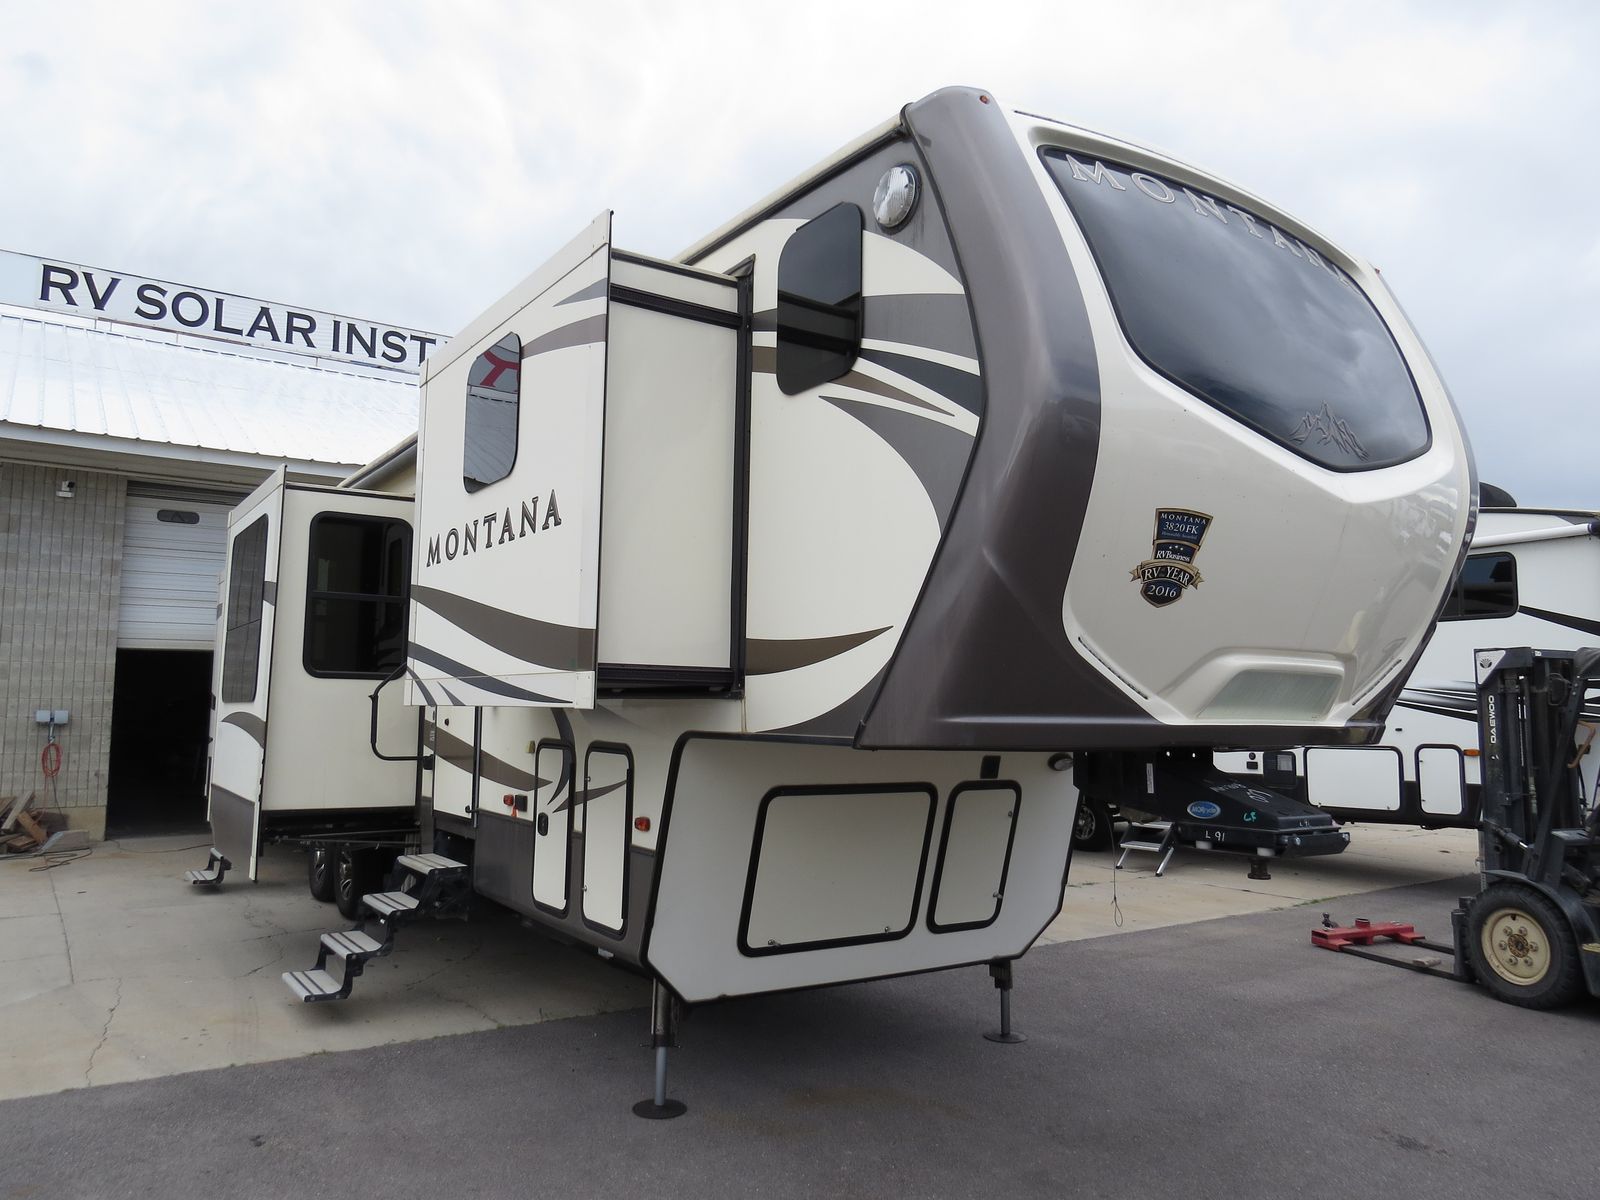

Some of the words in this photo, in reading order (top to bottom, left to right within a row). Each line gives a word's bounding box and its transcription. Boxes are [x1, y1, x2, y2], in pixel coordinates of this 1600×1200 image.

[1064, 152, 1363, 296] MONTANA
[39, 264, 121, 311] RV
[134, 283, 317, 348] SOLAR
[331, 319, 448, 367] INST
[426, 488, 562, 567] MONTANA
[1161, 513, 1206, 524] MONTANA
[1144, 567, 1161, 580] RV
[1166, 567, 1190, 585] YEAR
[1148, 585, 1176, 597] 2016
[1488, 695, 1497, 744] DAEWOO
